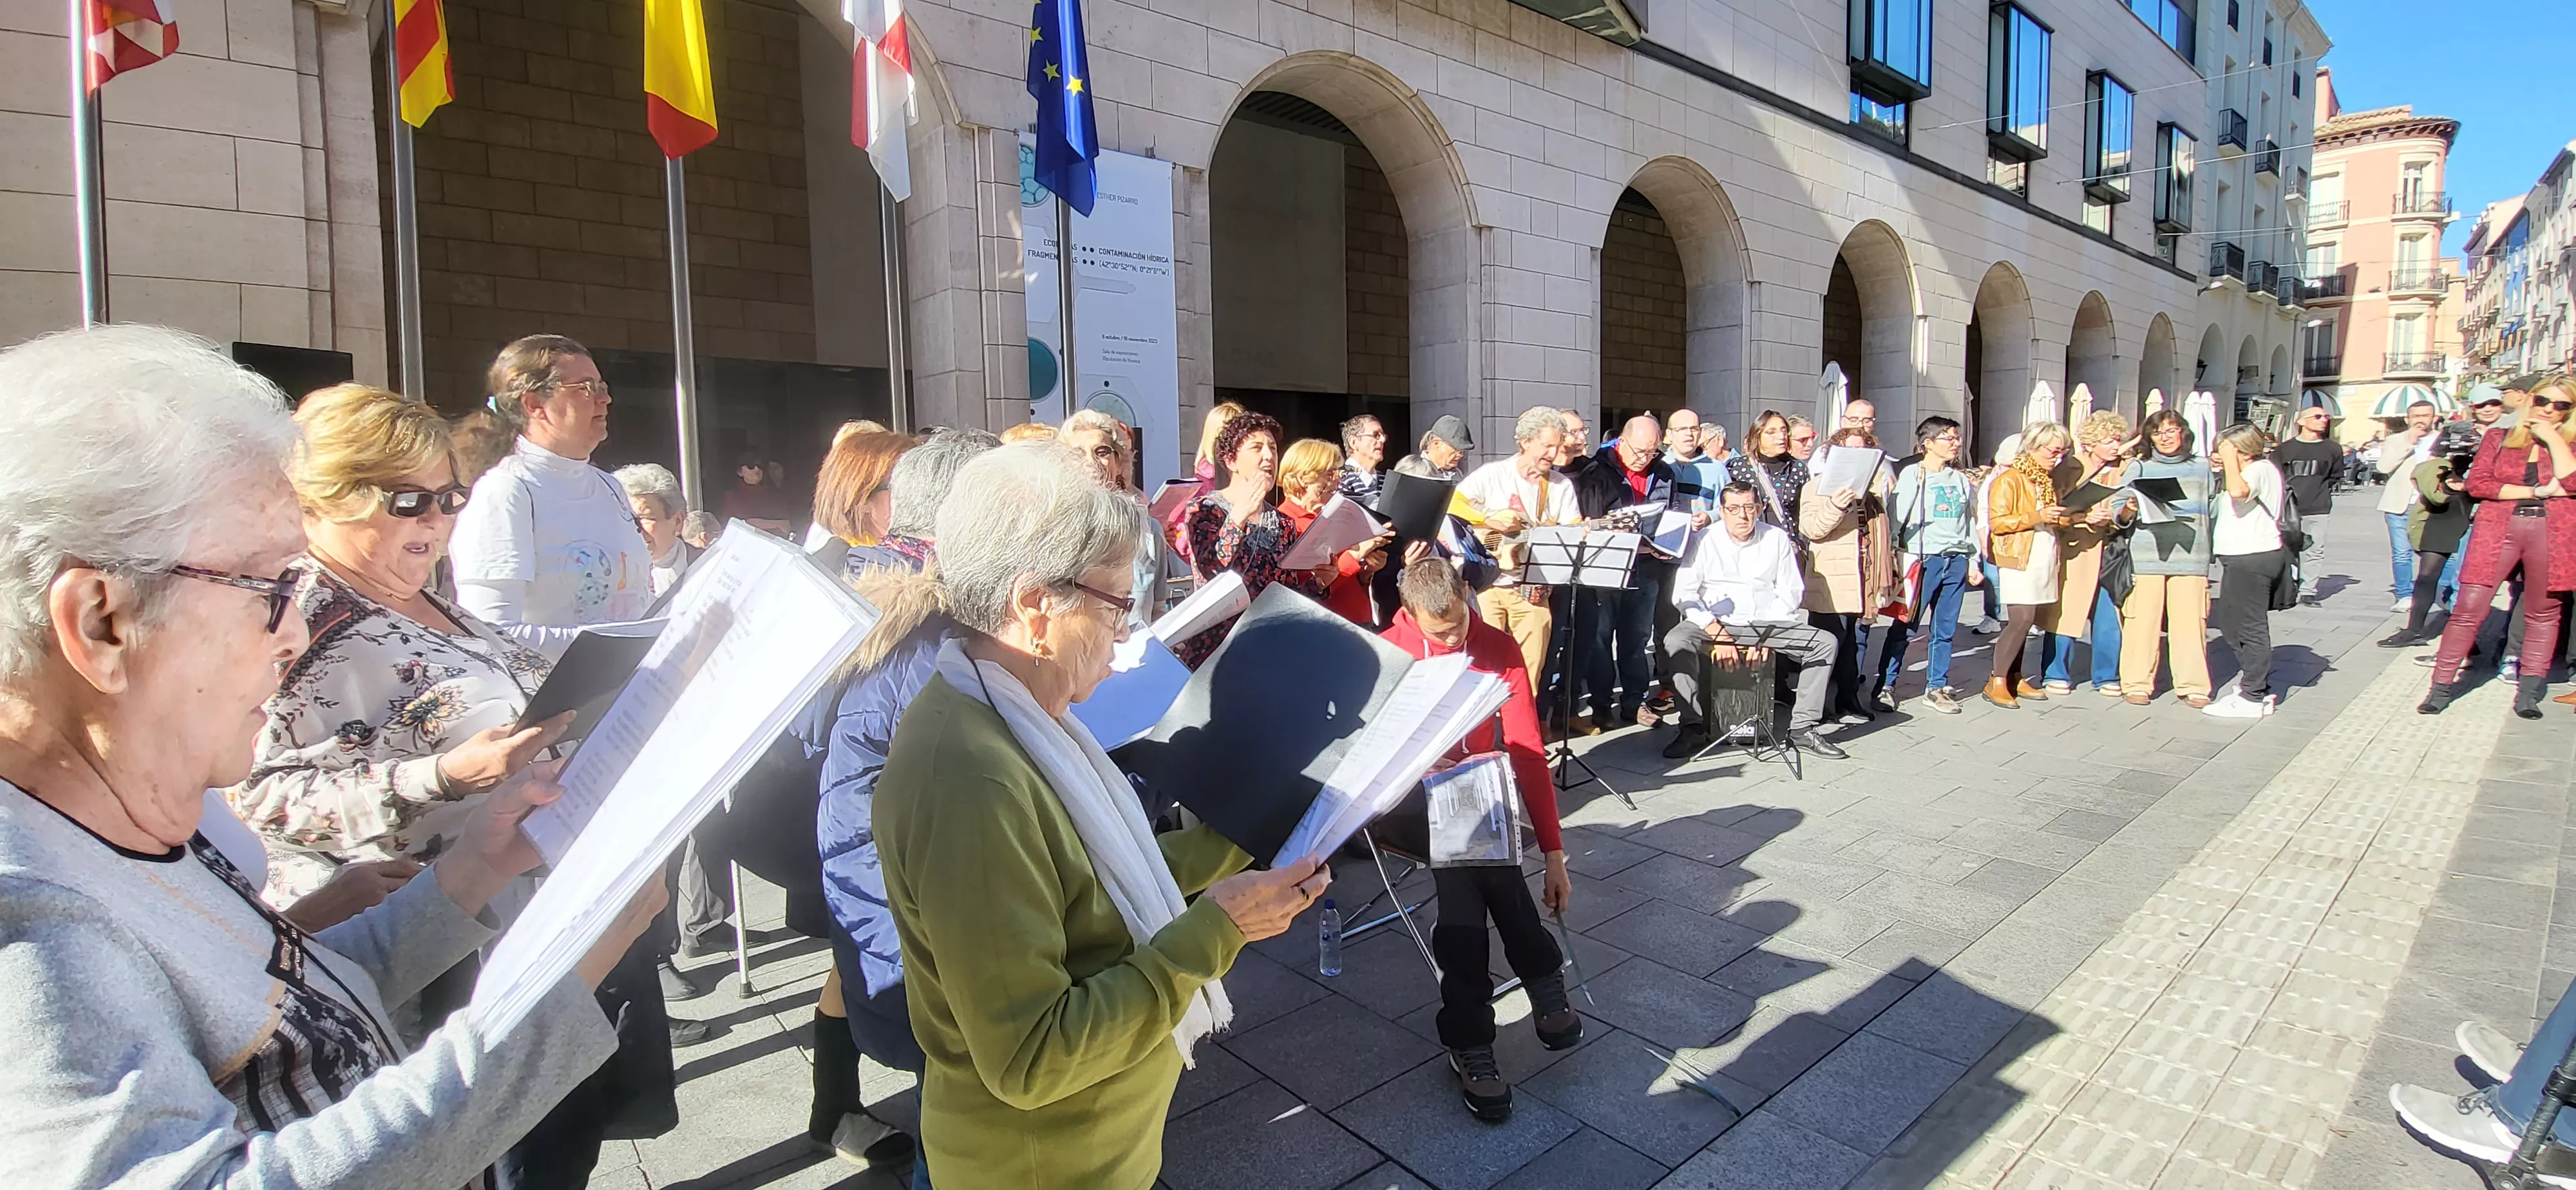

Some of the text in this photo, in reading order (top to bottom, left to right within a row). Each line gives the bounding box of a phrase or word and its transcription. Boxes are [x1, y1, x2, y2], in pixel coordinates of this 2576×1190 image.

[1117, 196, 1138, 205] PIZARRO
[1098, 248, 1170, 263] CONTAMINACIÓN HÍDRICA
